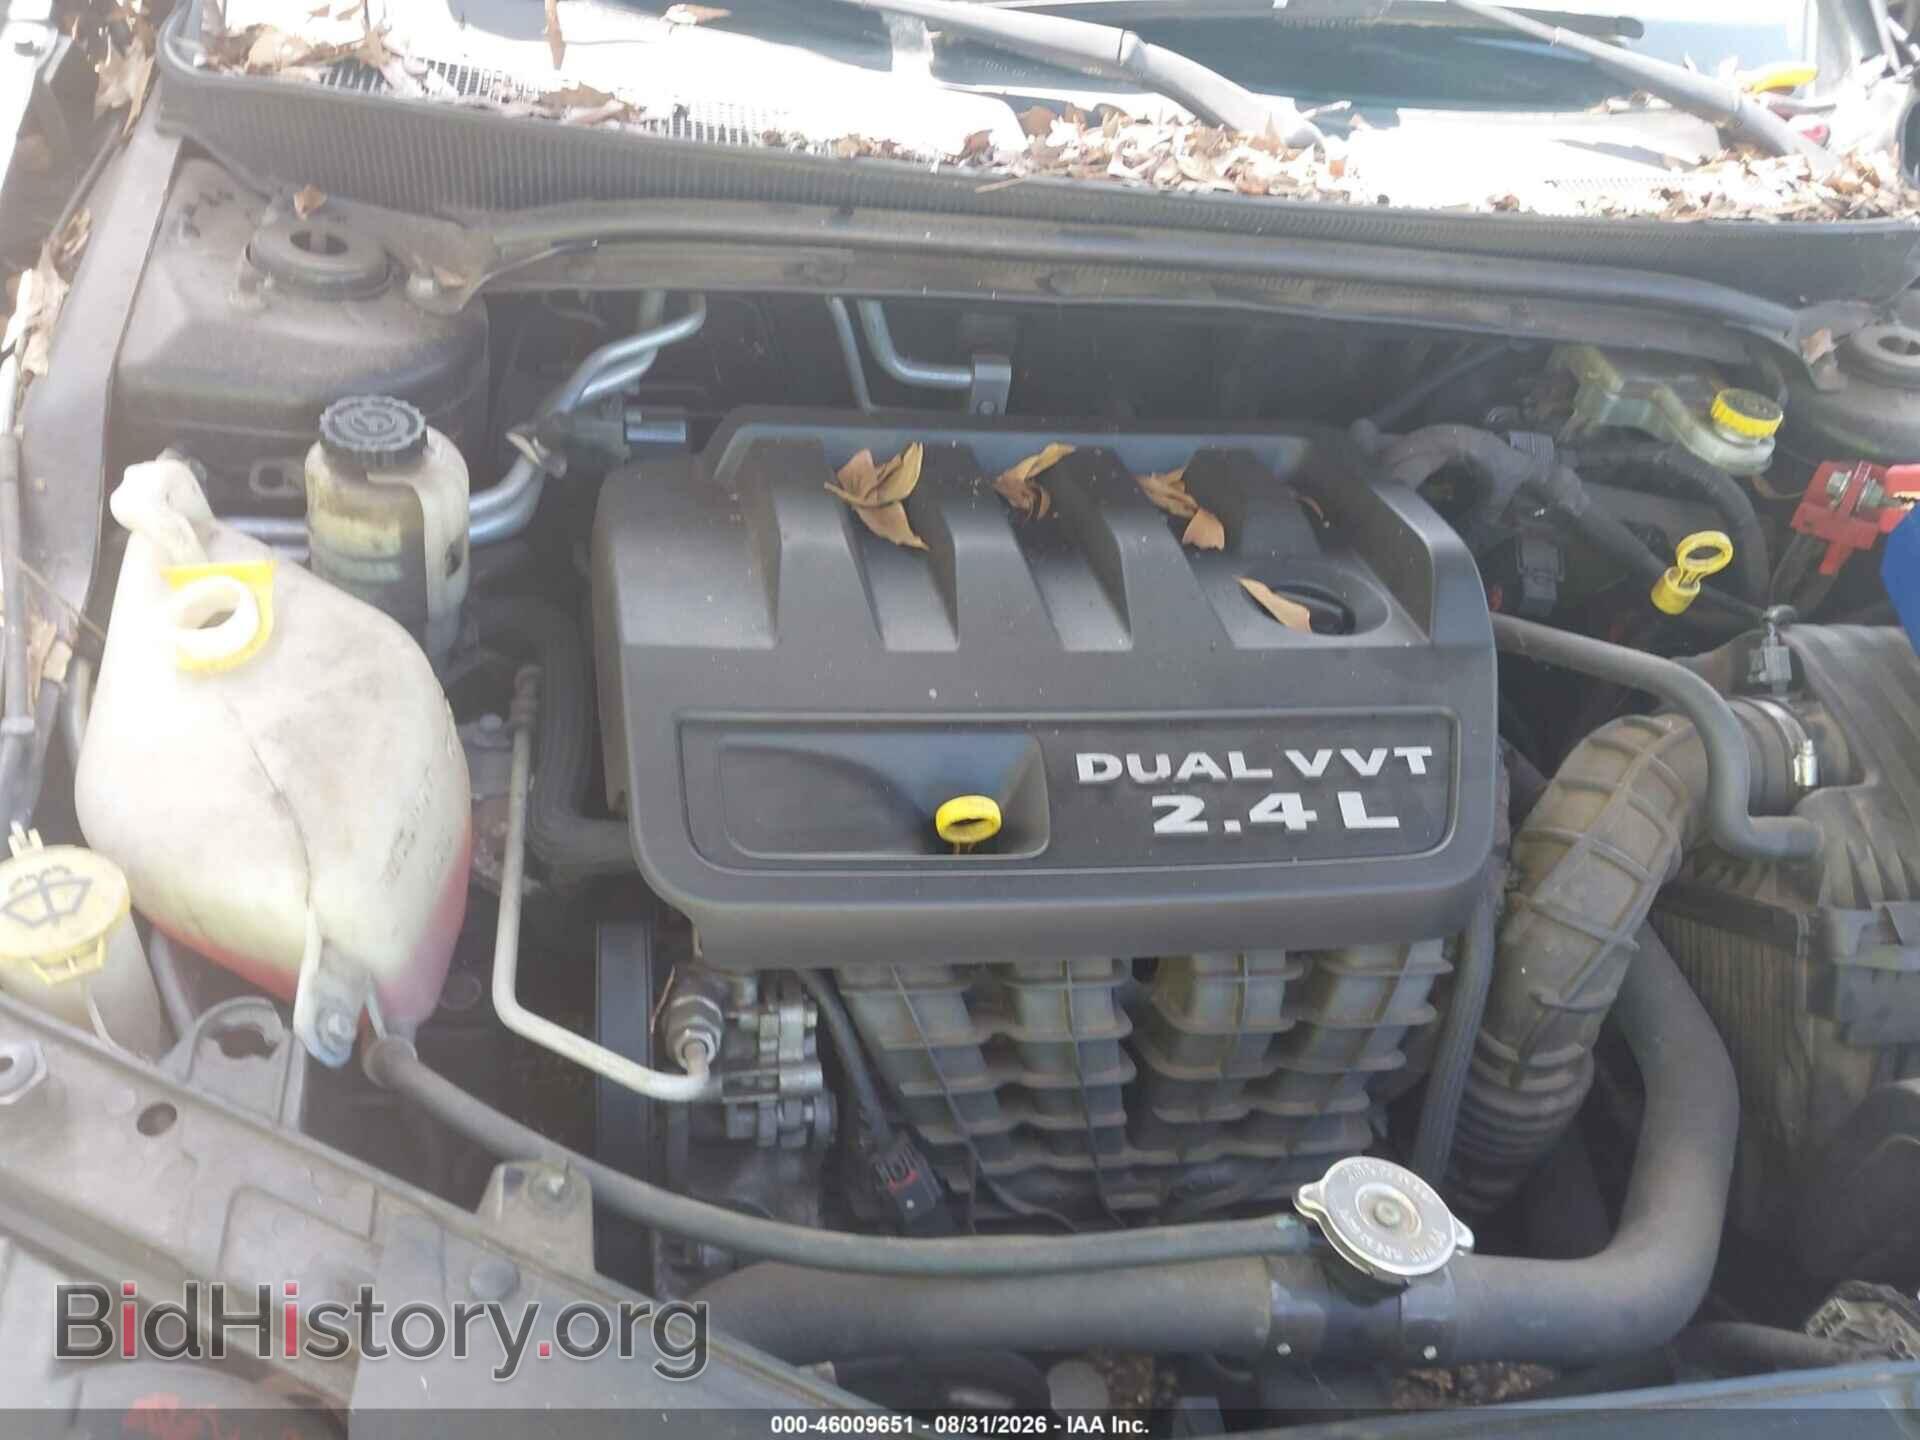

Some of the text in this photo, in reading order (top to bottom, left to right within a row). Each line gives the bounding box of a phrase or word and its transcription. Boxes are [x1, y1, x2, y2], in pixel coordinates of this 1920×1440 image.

[1075, 746, 1433, 783] DUAL VVT
[1151, 793, 1318, 833] 2.4
